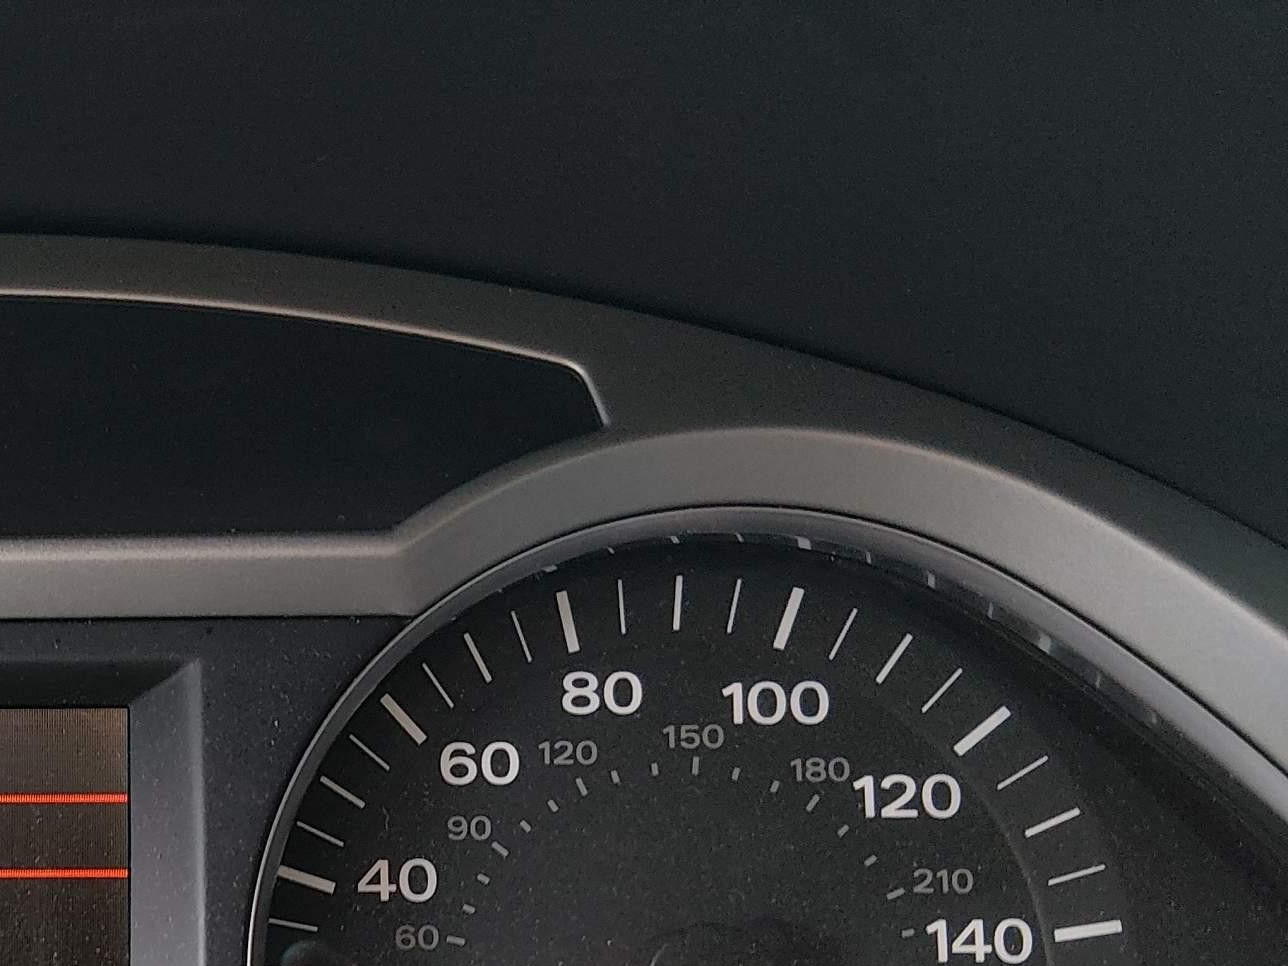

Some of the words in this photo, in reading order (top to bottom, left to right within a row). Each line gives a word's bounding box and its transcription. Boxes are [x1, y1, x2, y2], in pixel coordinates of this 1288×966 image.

[562, 672, 642, 714] 80
[722, 681, 829, 724] 100
[539, 741, 597, 764] 120
[663, 725, 724, 748] 150
[441, 742, 519, 784] 60
[791, 757, 850, 782] 180
[853, 774, 960, 818] 120
[448, 816, 491, 840] 90
[358, 859, 436, 901] 40
[914, 869, 973, 894] 210
[396, 925, 438, 949] 60
[926, 919, 1032, 963] 140
